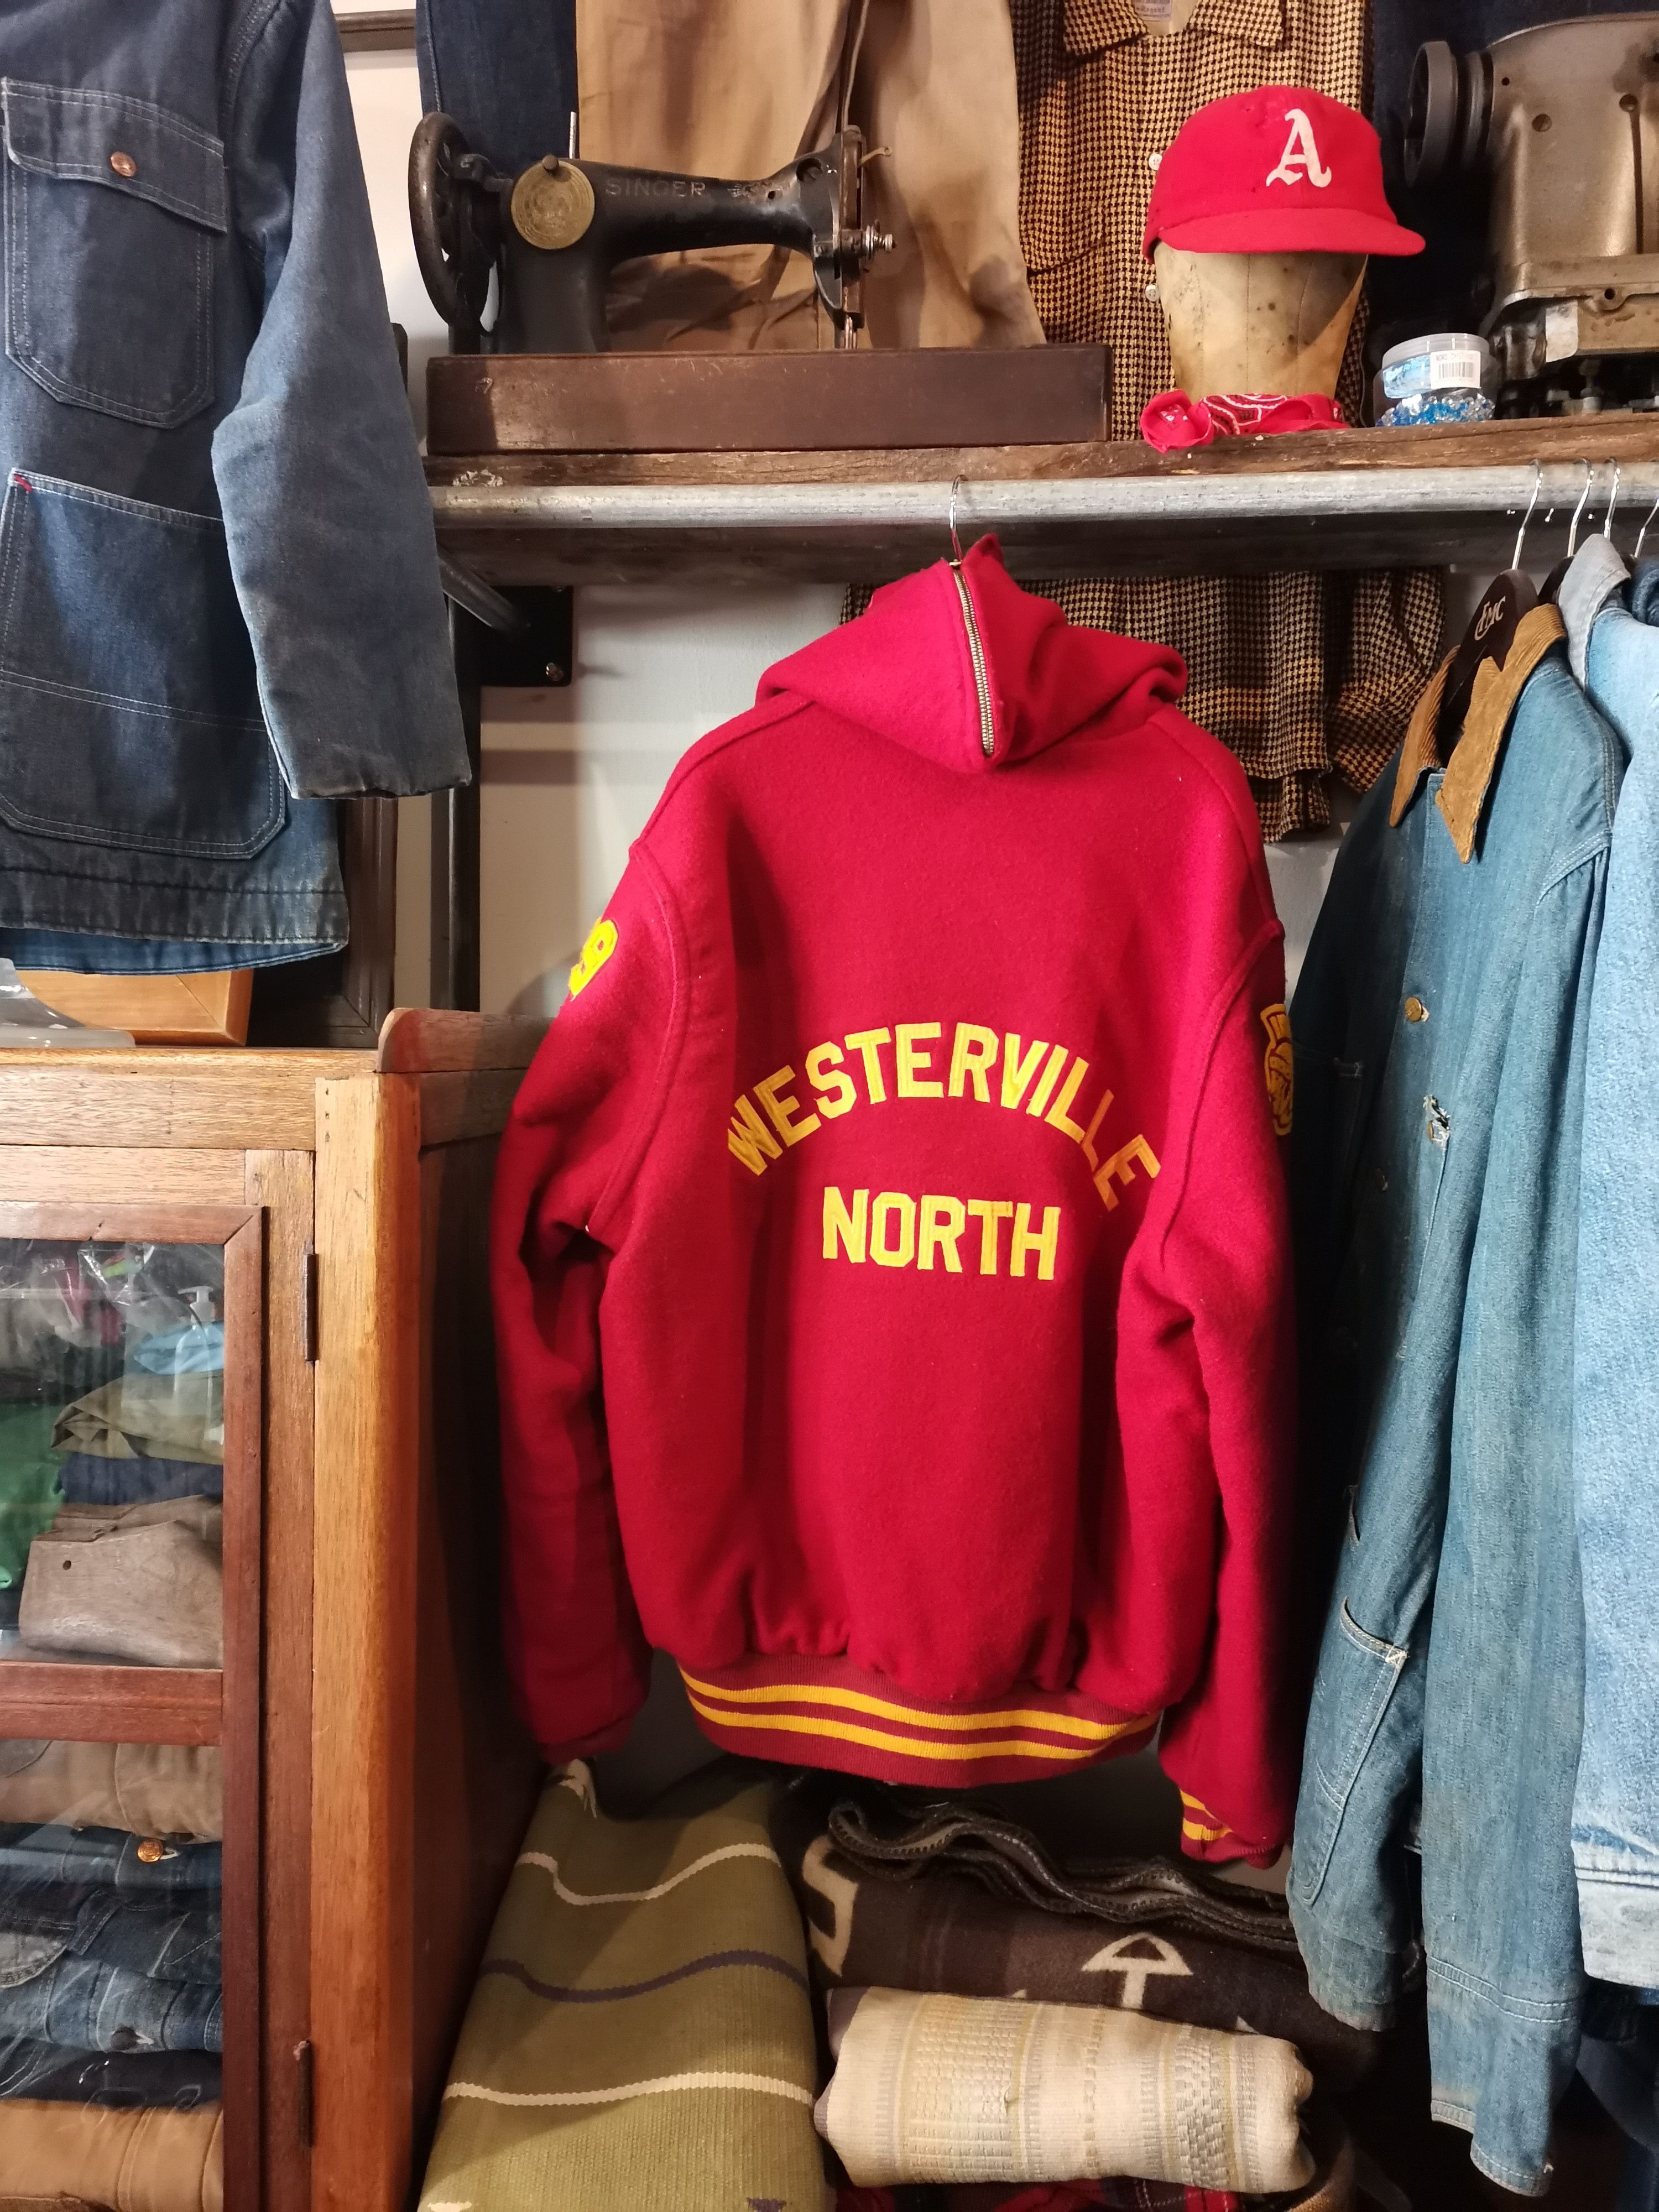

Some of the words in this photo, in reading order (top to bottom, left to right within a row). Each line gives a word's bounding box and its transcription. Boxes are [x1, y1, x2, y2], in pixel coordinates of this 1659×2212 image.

[606, 179, 706, 197] SINGER
[1266, 108, 1332, 188] A
[727, 1021, 1161, 1211] WESTERVILLE
[822, 1186, 1061, 1280] NORTH
